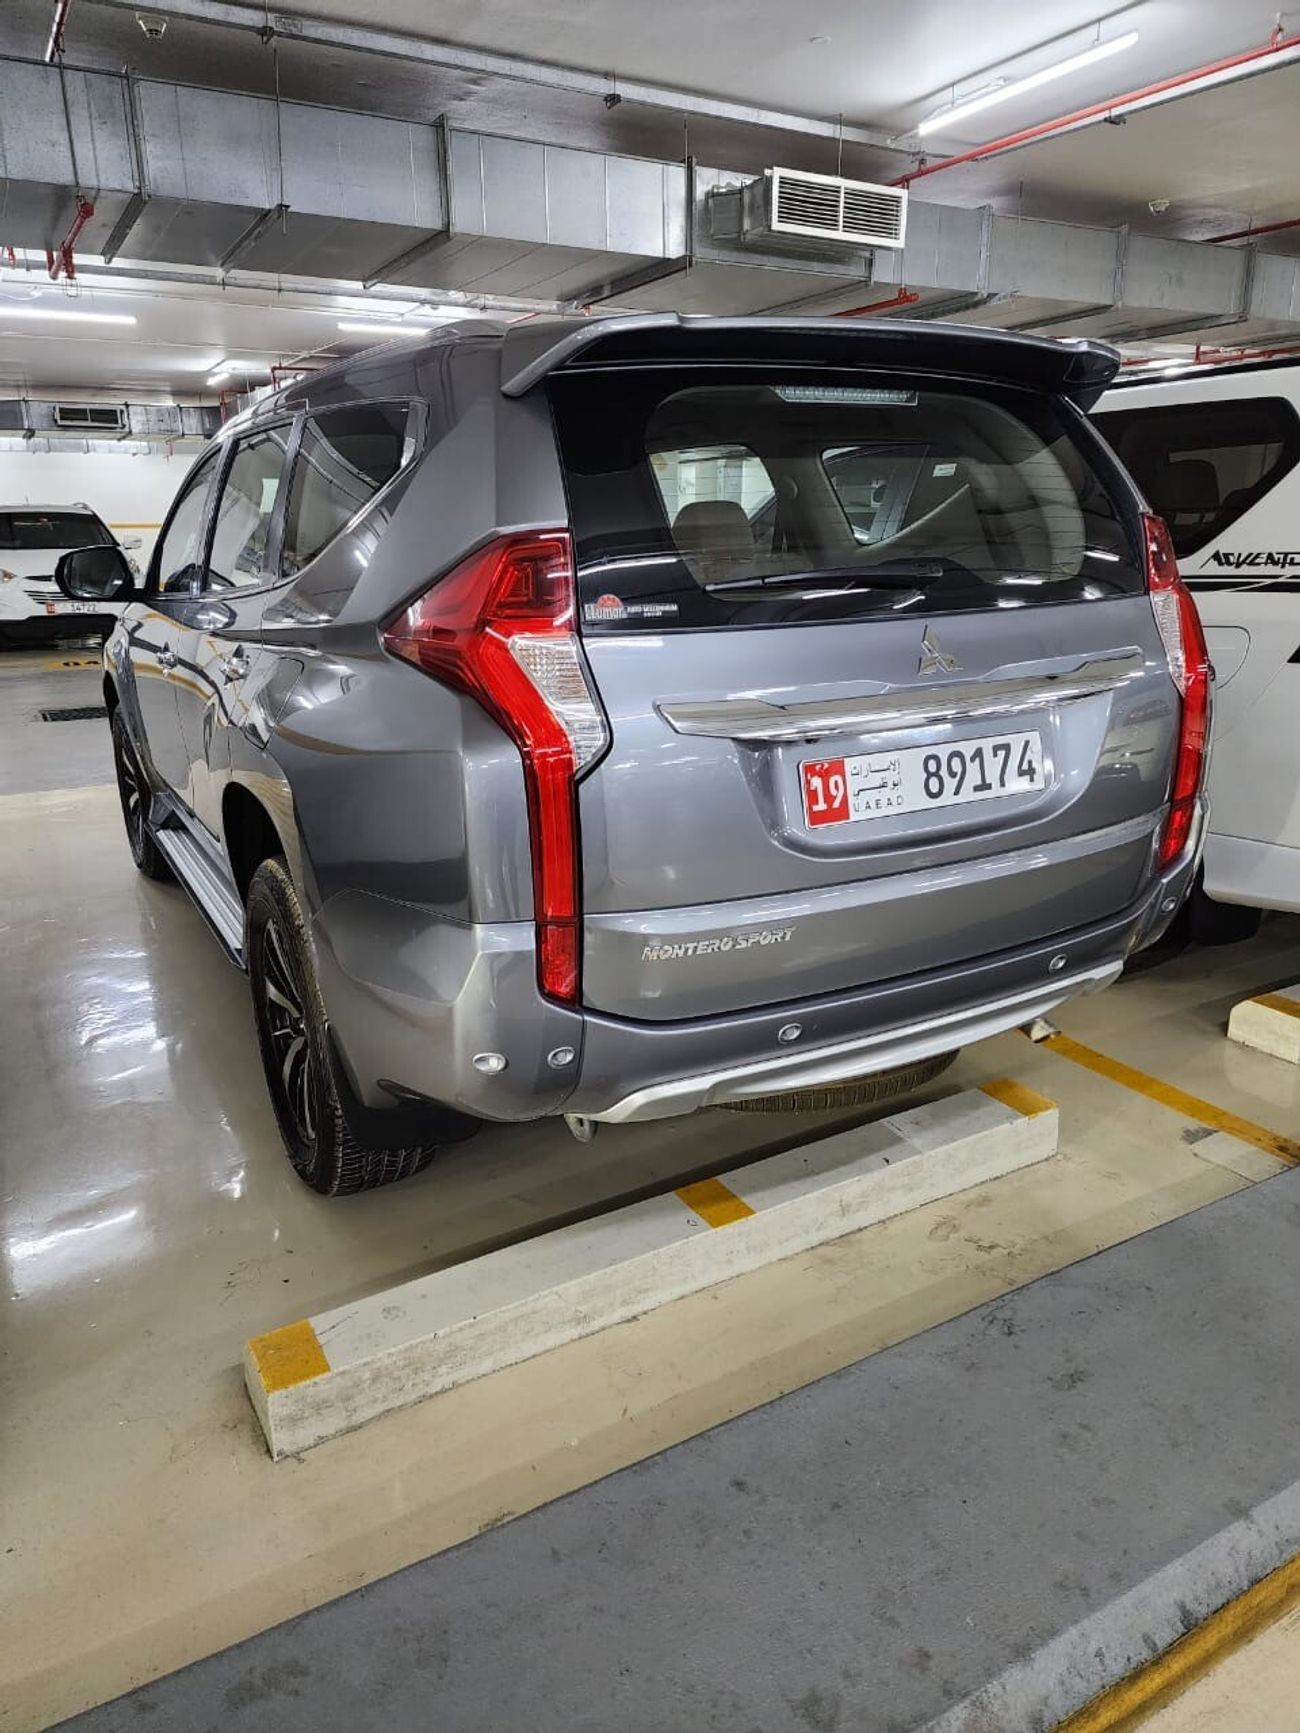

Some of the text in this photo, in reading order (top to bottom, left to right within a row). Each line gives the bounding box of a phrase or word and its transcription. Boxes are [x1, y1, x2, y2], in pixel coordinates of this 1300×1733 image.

[922, 739, 1037, 800] 89174
[809, 774, 845, 812] 19
[641, 926, 797, 961] MONTERO SPORT
